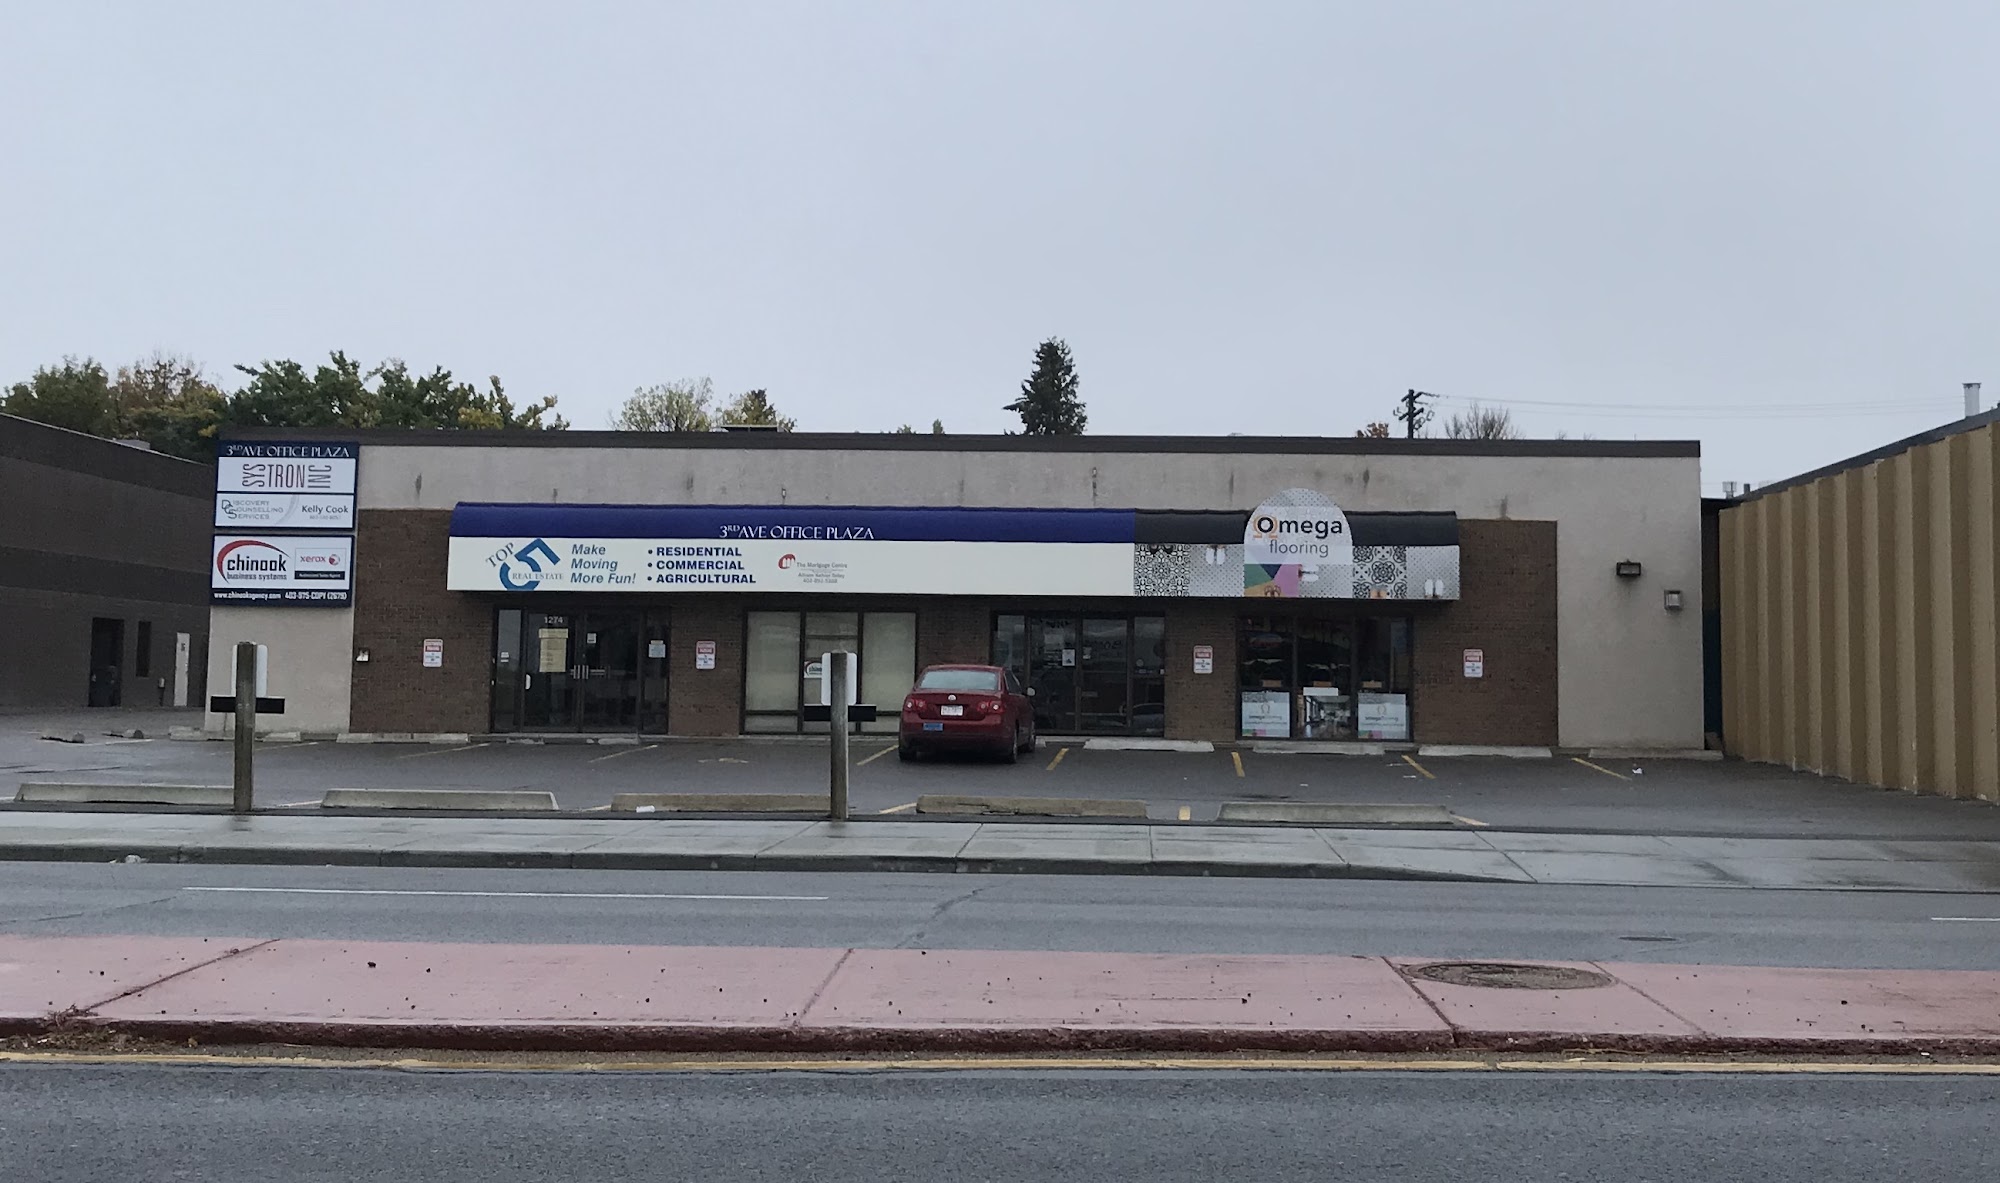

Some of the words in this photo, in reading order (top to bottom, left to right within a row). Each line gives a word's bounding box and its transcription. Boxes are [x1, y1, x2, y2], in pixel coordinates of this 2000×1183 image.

[242, 446, 264, 456] AVE
[267, 446, 308, 457] OFFICE
[311, 447, 350, 458] PLAZA
[308, 465, 332, 489] INC
[302, 505, 324, 515] Kelly
[325, 505, 349, 514] Cook
[739, 526, 767, 538] AVE
[770, 525, 823, 539] OFFICE
[826, 527, 875, 540] PLAZA
[1256, 515, 1343, 539] Omega
[571, 544, 606, 555] Make
[656, 547, 742, 557] RESIDENTIAL
[1269, 539, 1329, 558] flooring
[300, 555, 326, 563] xerox
[485, 542, 515, 568] TOP
[227, 554, 287, 572] chinook
[570, 558, 618, 572] Moving
[656, 560, 745, 570] COMMERCIAL
[227, 572, 257, 580] business
[258, 573, 287, 582] systems
[570, 573, 604, 584] More
[607, 573, 636, 584] Fun!
[656, 574, 757, 584] AGRICULTURAL
[544, 616, 564, 624] 1274
